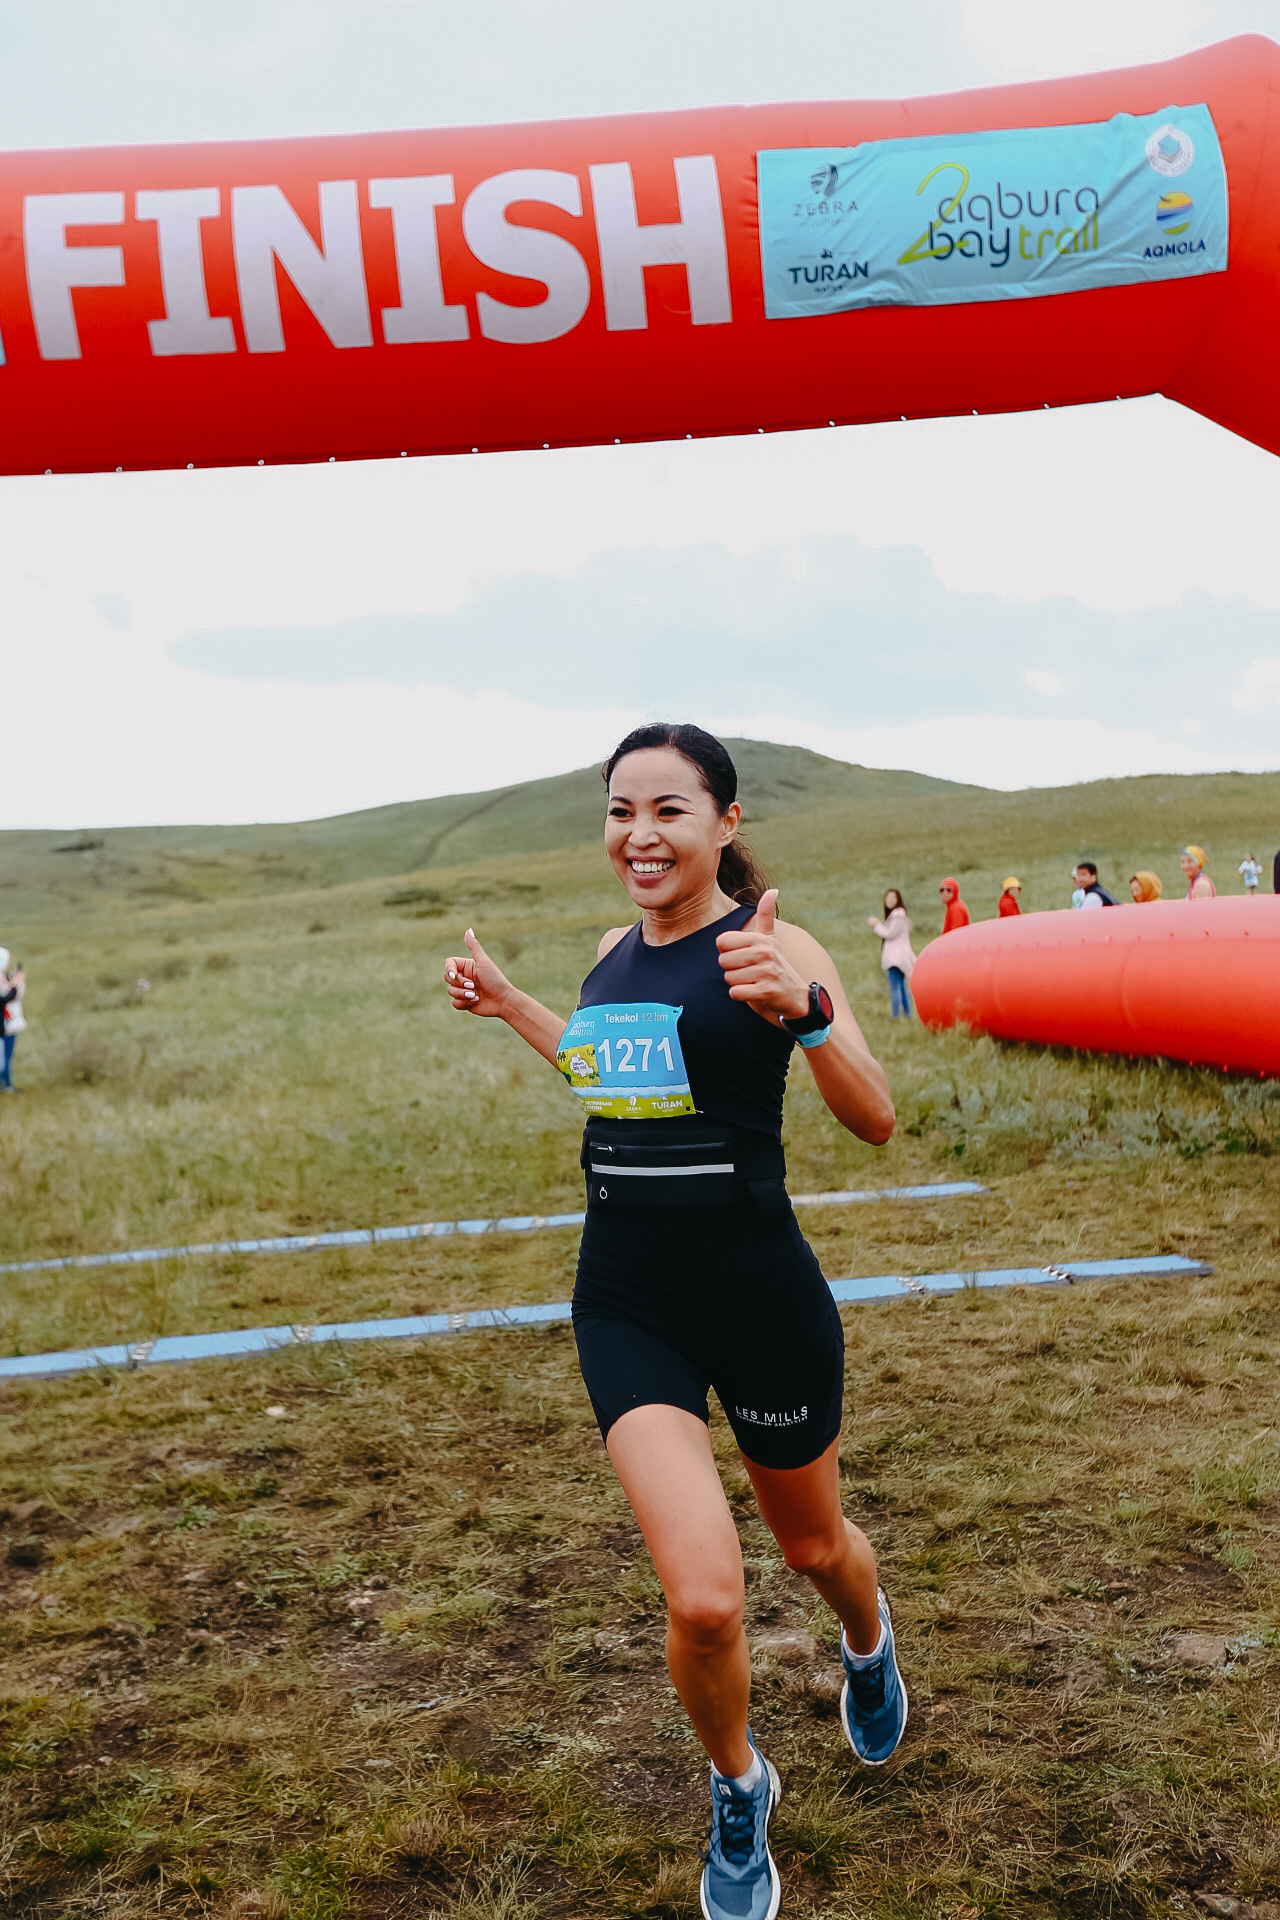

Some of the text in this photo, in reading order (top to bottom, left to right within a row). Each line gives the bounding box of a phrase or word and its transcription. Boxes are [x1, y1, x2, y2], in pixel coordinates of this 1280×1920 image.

[792, 201, 859, 217] ZEBRA
[24, 154, 733, 360] FINISH
[1143, 238, 1206, 258] AQMOLA
[788, 261, 868, 284] TURAN
[604, 1012, 639, 1023] Tekekol
[654, 1011, 668, 1022] km
[597, 1036, 675, 1073] 1271
[651, 1100, 683, 1110] TURAN
[735, 1405, 758, 1420] LES
[764, 1405, 808, 1423] MILLS
